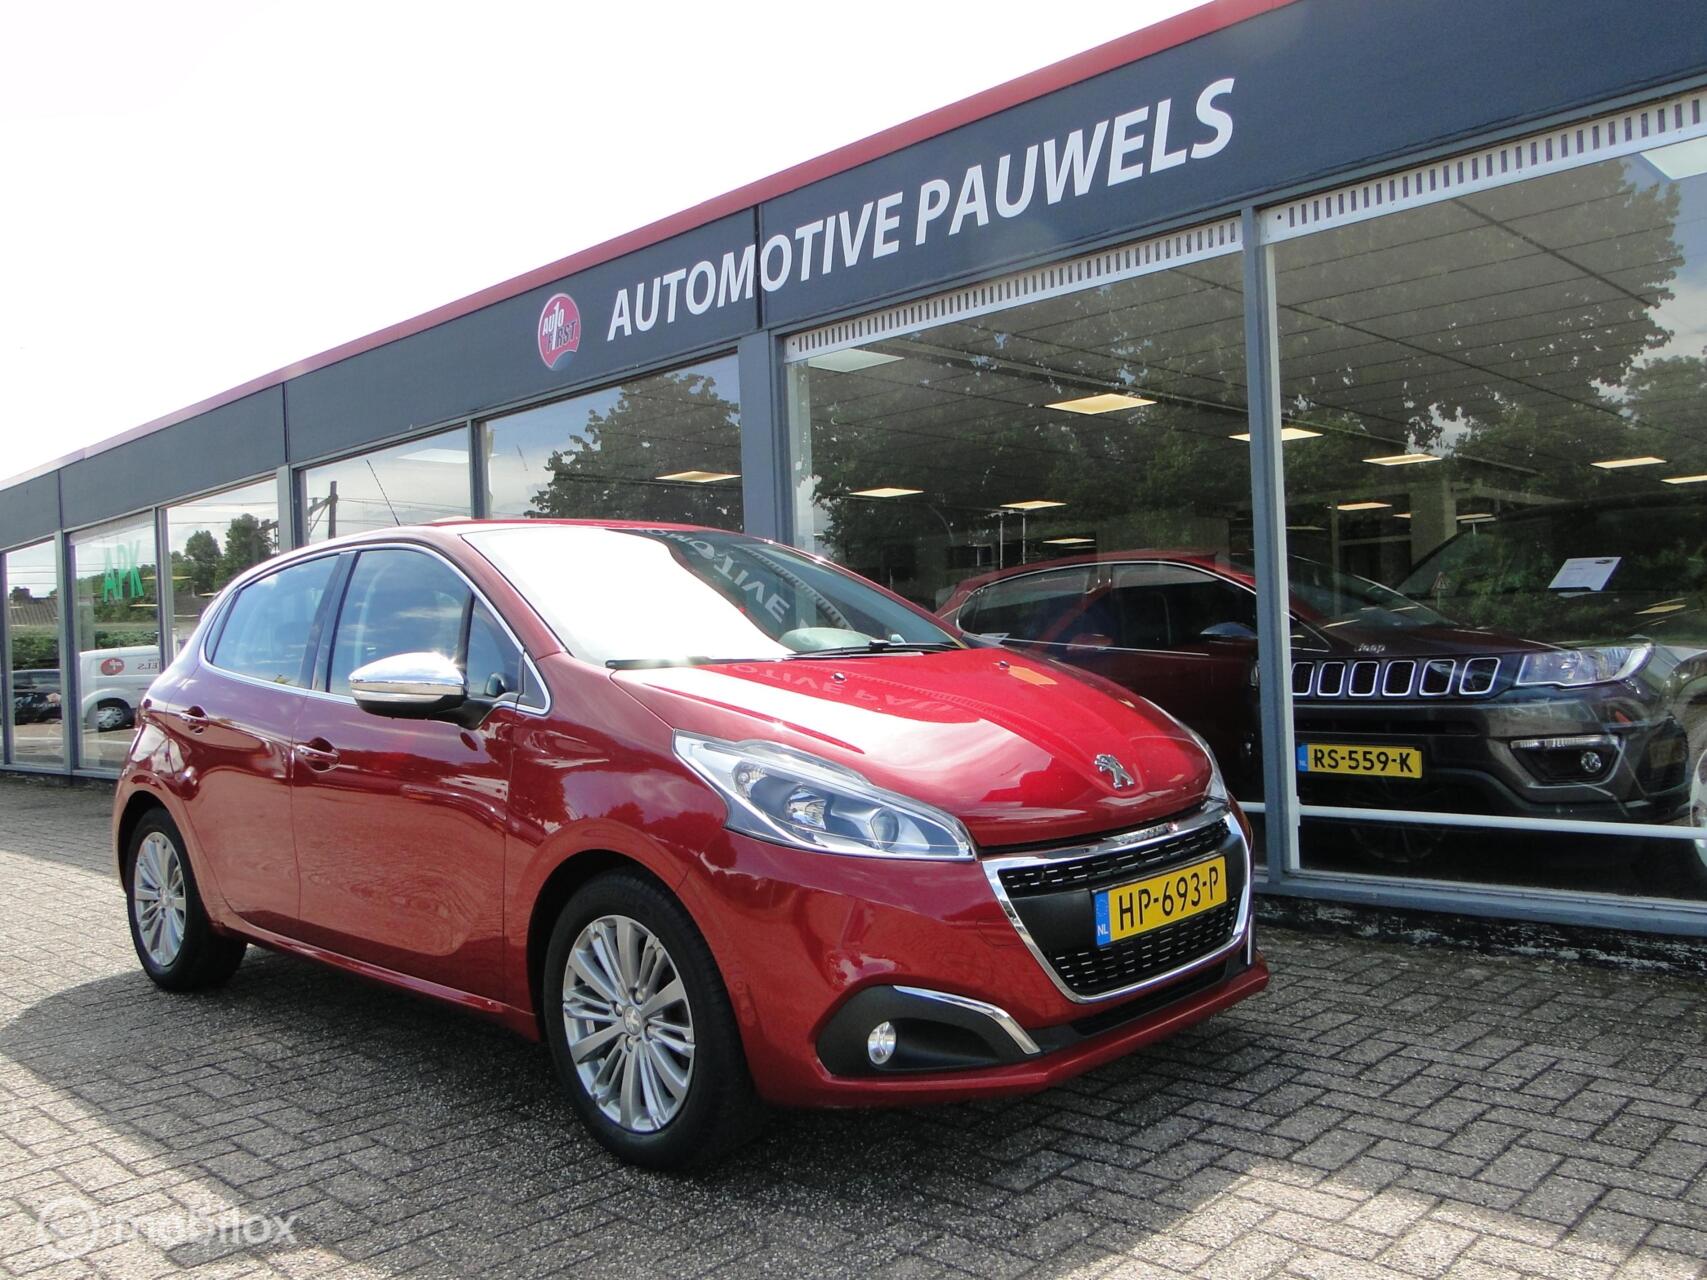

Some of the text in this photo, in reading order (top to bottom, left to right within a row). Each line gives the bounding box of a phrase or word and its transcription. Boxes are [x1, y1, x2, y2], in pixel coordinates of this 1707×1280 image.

[607, 77, 1235, 342] AUTOMOTIVE PAUWELS
[103, 539, 145, 602] APK
[1313, 748, 1413, 773] RS-559-K
[1118, 865, 1219, 931] HP-693-P
[1097, 924, 1109, 937] NL
